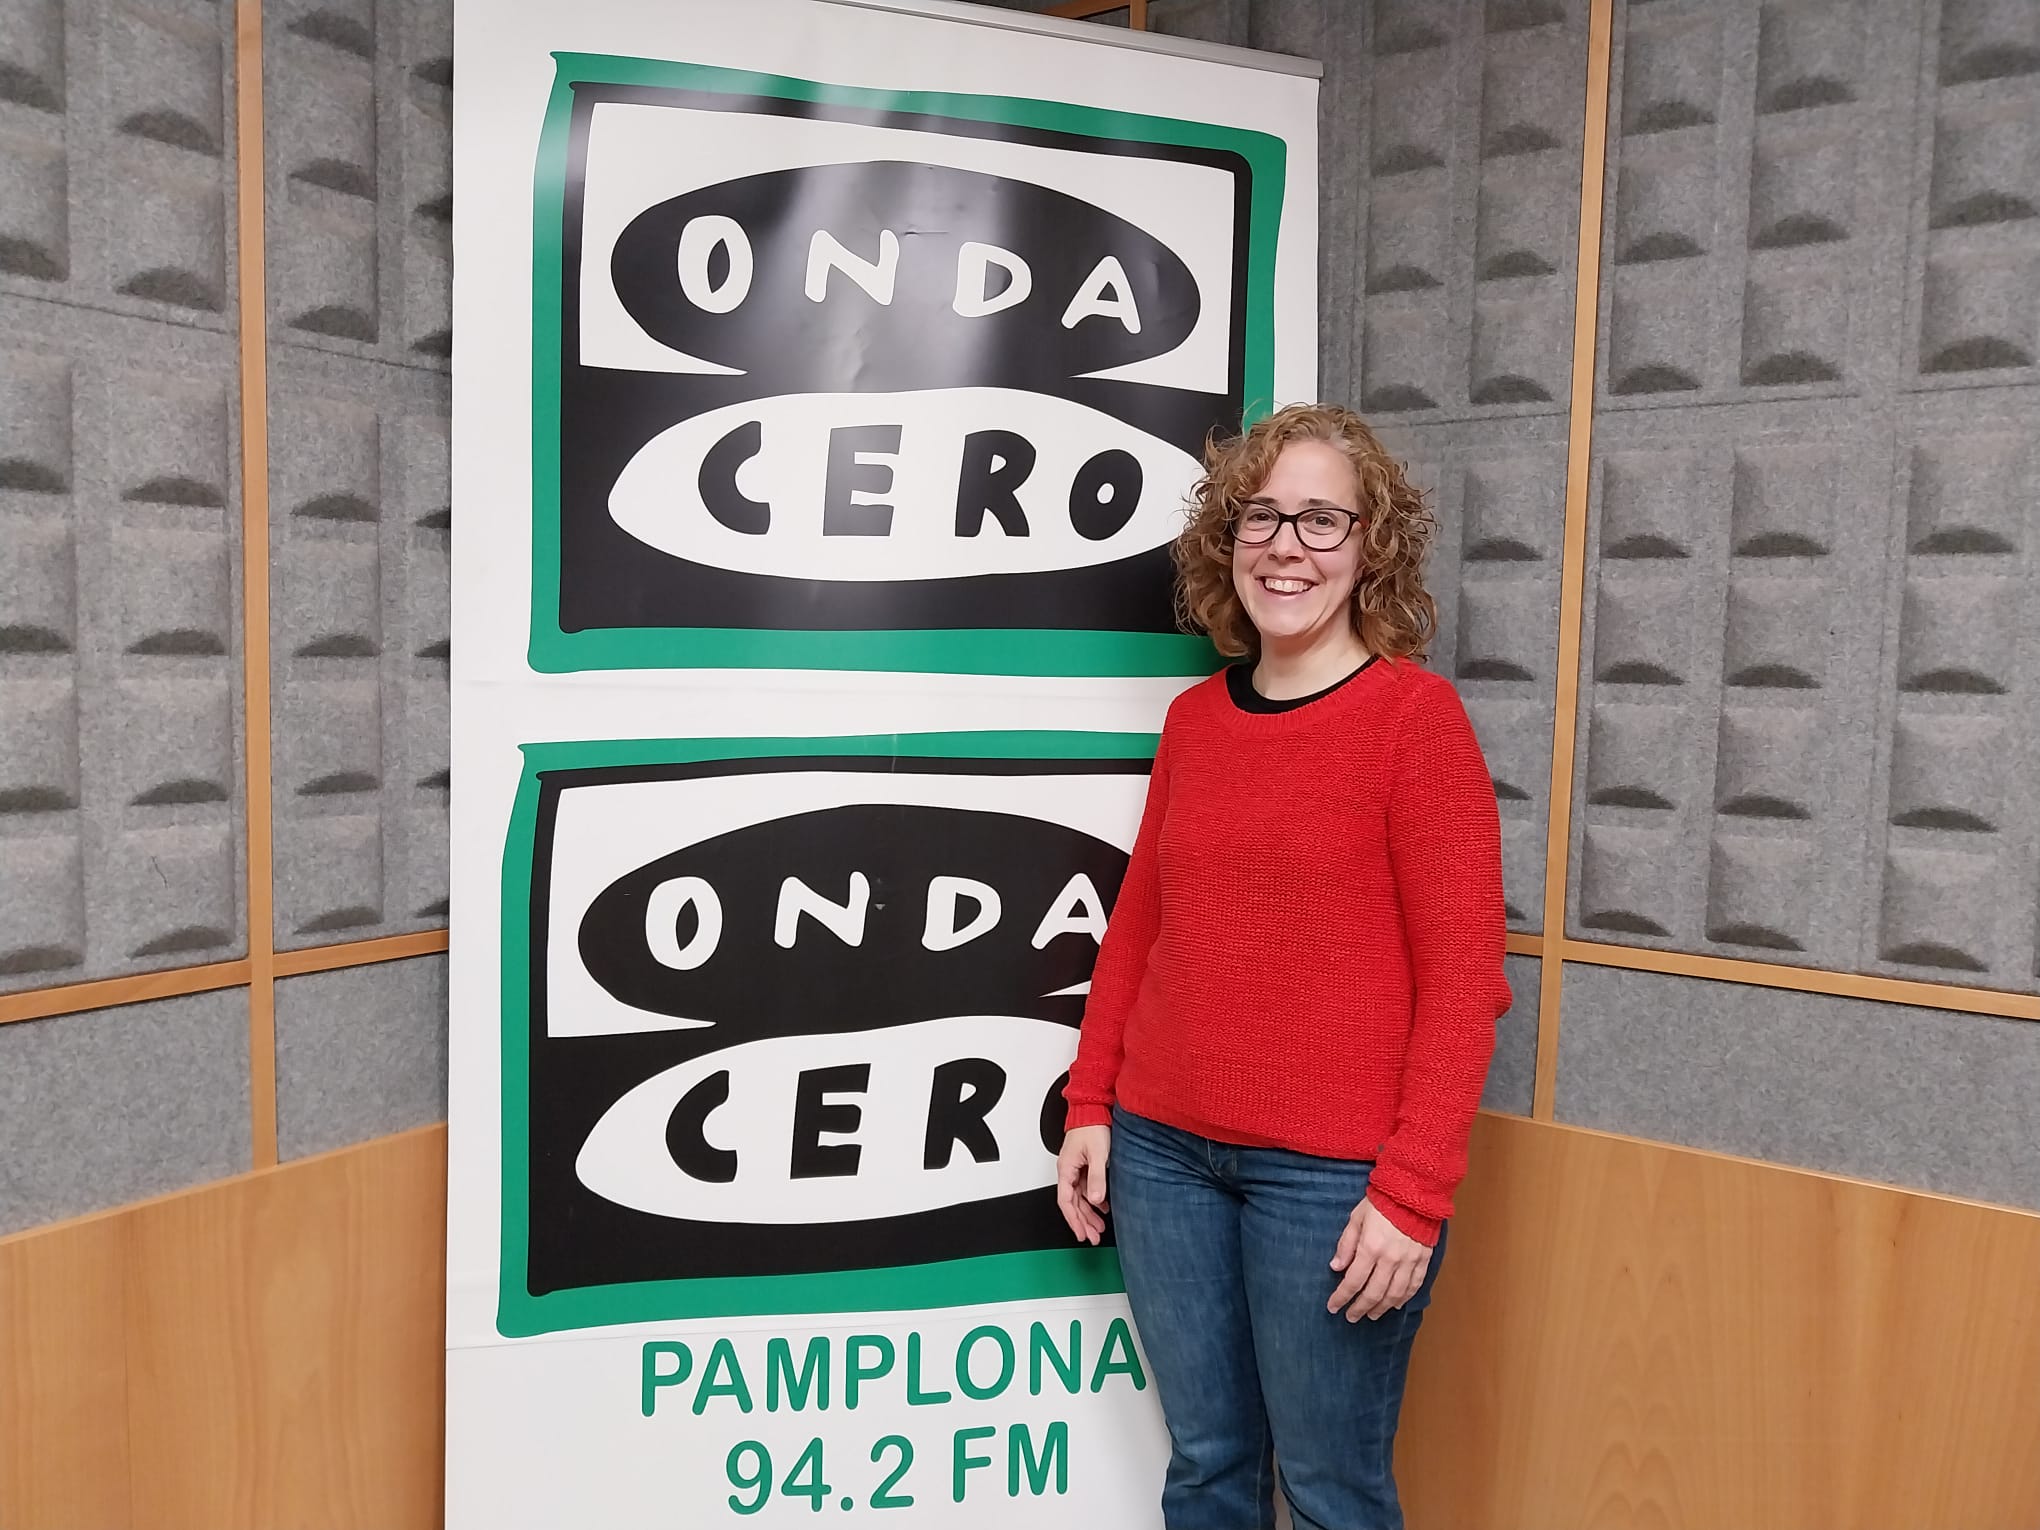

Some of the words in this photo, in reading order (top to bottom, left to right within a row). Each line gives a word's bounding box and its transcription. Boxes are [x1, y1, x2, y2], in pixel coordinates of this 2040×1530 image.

[677, 215, 1142, 334] ONDA
[698, 420, 1143, 541] CERO
[645, 871, 1109, 970] ONDA
[642, 1317, 1146, 1417] PAMPLONA
[726, 1435, 914, 1515] 94.2
[953, 1421, 1068, 1502] FM
